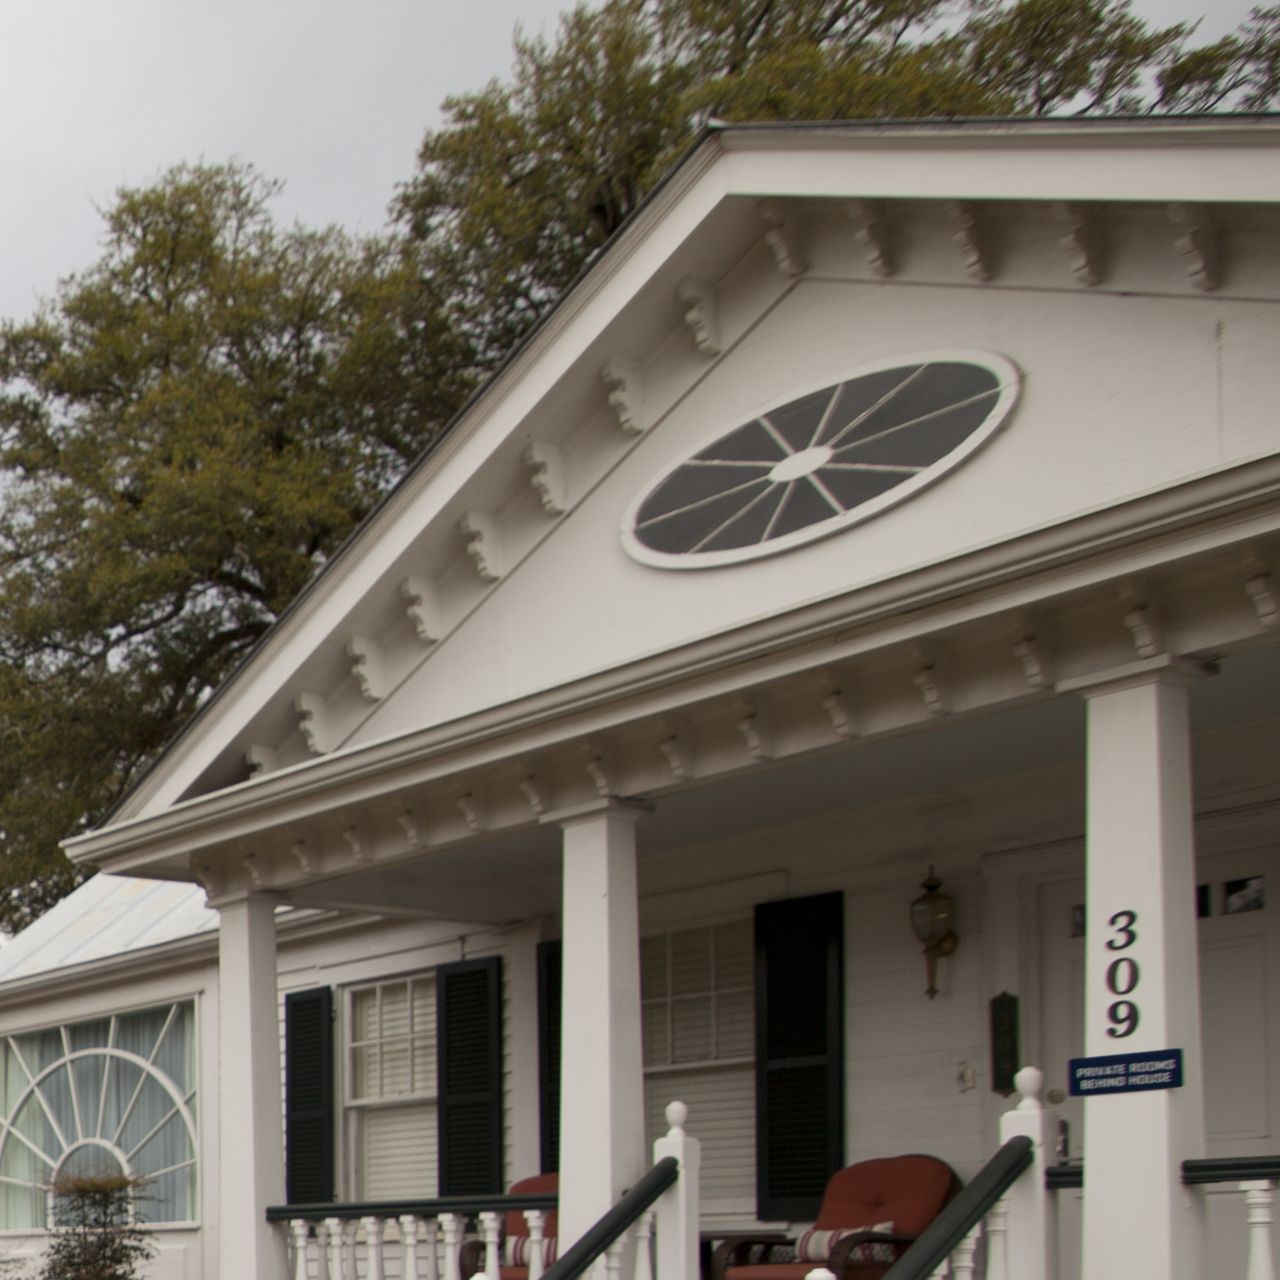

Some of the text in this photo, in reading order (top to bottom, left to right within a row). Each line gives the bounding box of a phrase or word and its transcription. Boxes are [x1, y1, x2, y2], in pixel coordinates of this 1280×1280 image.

[1105, 910, 1140, 1039] 309
[1076, 1059, 1176, 1079] PRIVATE ROOMS
[1080, 1071, 1173, 1090] BEHIND HOUSE
